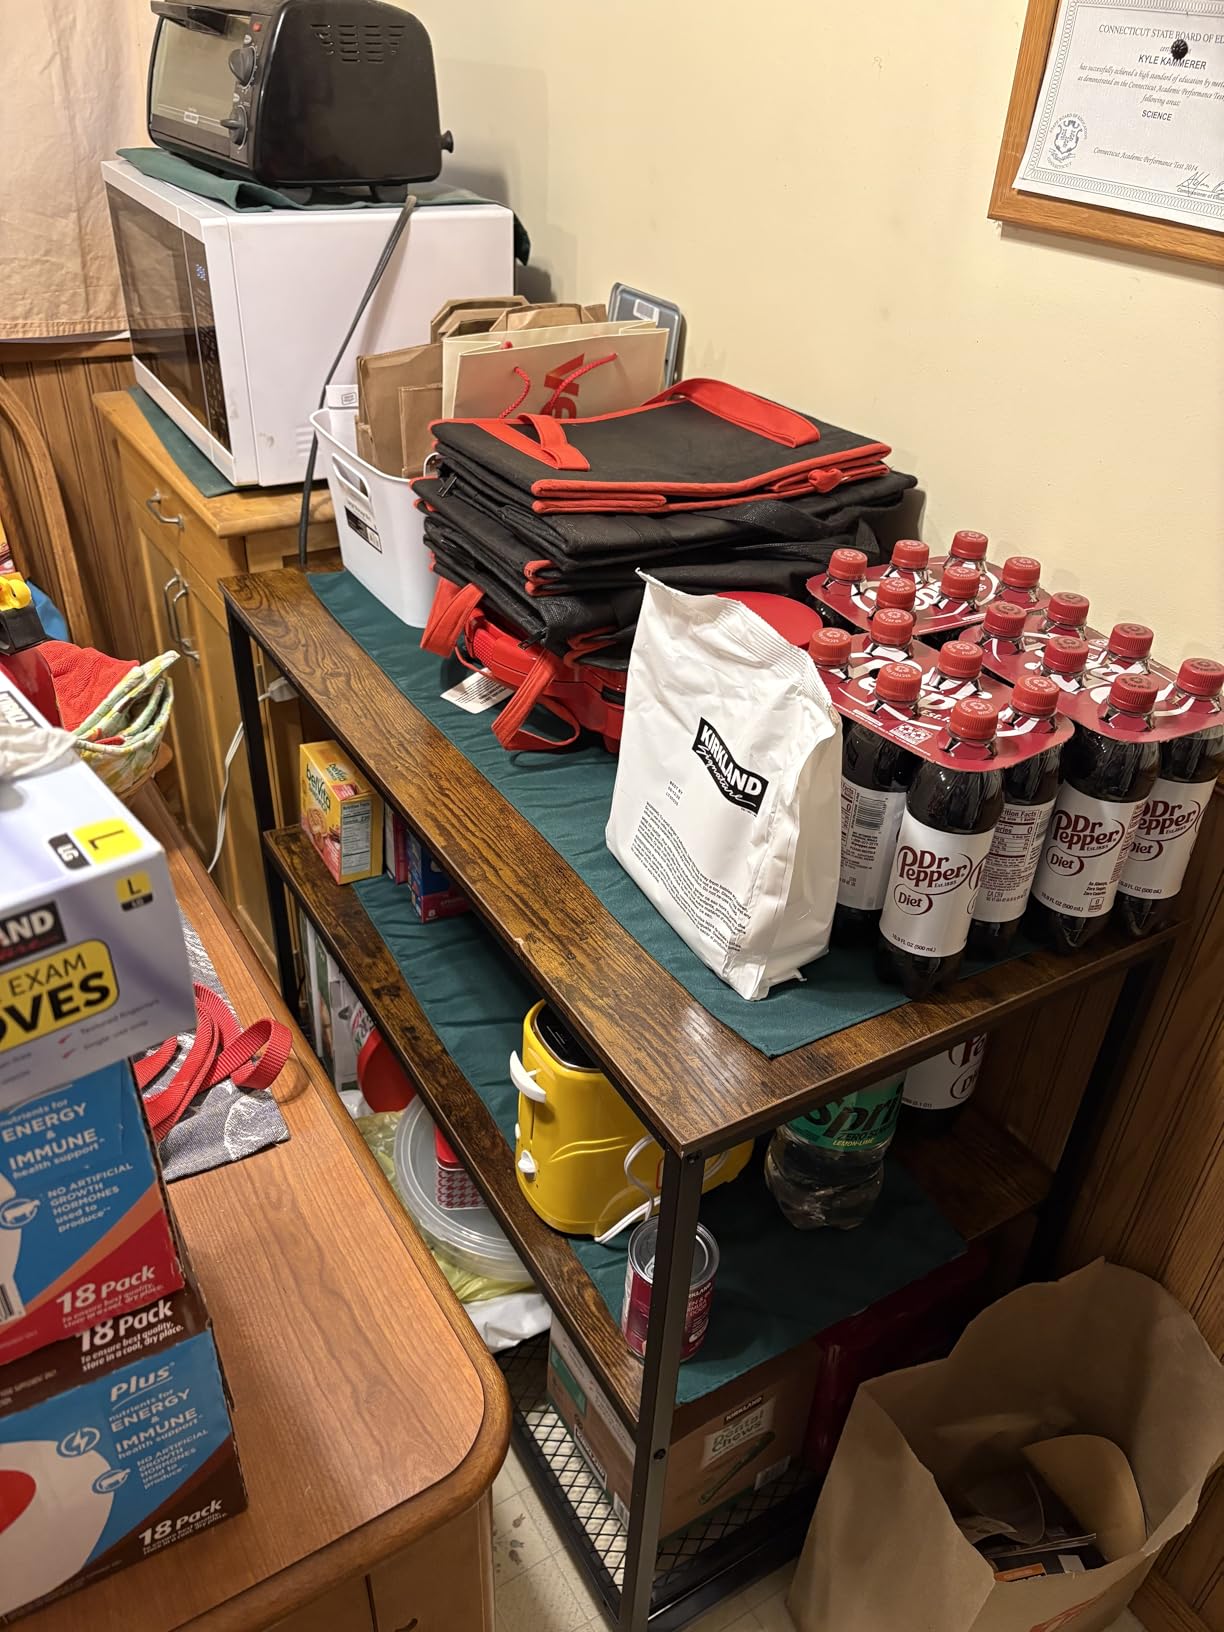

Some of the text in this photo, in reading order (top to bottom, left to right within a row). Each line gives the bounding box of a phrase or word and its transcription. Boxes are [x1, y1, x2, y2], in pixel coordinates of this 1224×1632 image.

[1098, 24, 1151, 37] CONNECTICUT
[1151, 28, 1174, 39] STATE
[1174, 30, 1202, 42] BOARD
[1202, 33, 1214, 43] OF
[1138, 54, 1159, 65] KYLE
[1141, 109, 1173, 121] SCIENCE
[1184, 163, 1198, 172] 2014
[695, 744, 757, 808] Signature
[700, 724, 763, 797] KIRKLAND
[1070, 814, 1103, 834] Dr
[1149, 800, 1182, 817] Dr
[88, 829, 125, 850] L
[1052, 809, 1121, 851] Pepper
[897, 845, 968, 888] Pepper
[918, 849, 950, 870] Dr
[1050, 853, 1075, 870] Diet
[127, 877, 142, 896] L
[897, 891, 923, 908] Diet
[8, 952, 87, 997] EXAM
[2, 1102, 87, 1143] ENERGY
[9, 1128, 98, 1171] IMMUNE
[12, 1160, 52, 1180] health
[47, 1162, 134, 1198] NO ARTIFICIAL
[50, 1181, 104, 1207] GROWTH
[52, 1185, 121, 1216] HORMONES
[55, 1204, 98, 1225] used to
[56, 1264, 157, 1315] 18 Pack
[75, 1318, 115, 1352] 18
[119, 1302, 174, 1336] Pack
[91, 1342, 121, 1359] ensure
[121, 1333, 141, 1345] best
[141, 1320, 174, 1339] quality,
[105, 1352, 114, 1361] in
[143, 1334, 158, 1347] dry
[157, 1323, 185, 1340] place.
[109, 1388, 174, 1422] nutrients for
[111, 1388, 190, 1433] ENERGY
[115, 1407, 198, 1453] IMMUNE
[155, 1429, 209, 1457] ARTIFICIAL
[118, 1440, 153, 1460] health
[138, 1447, 184, 1473] GROWTH
[140, 1447, 197, 1478] HORMONES
[138, 1519, 173, 1546] 18
[175, 1499, 223, 1530] Pack
